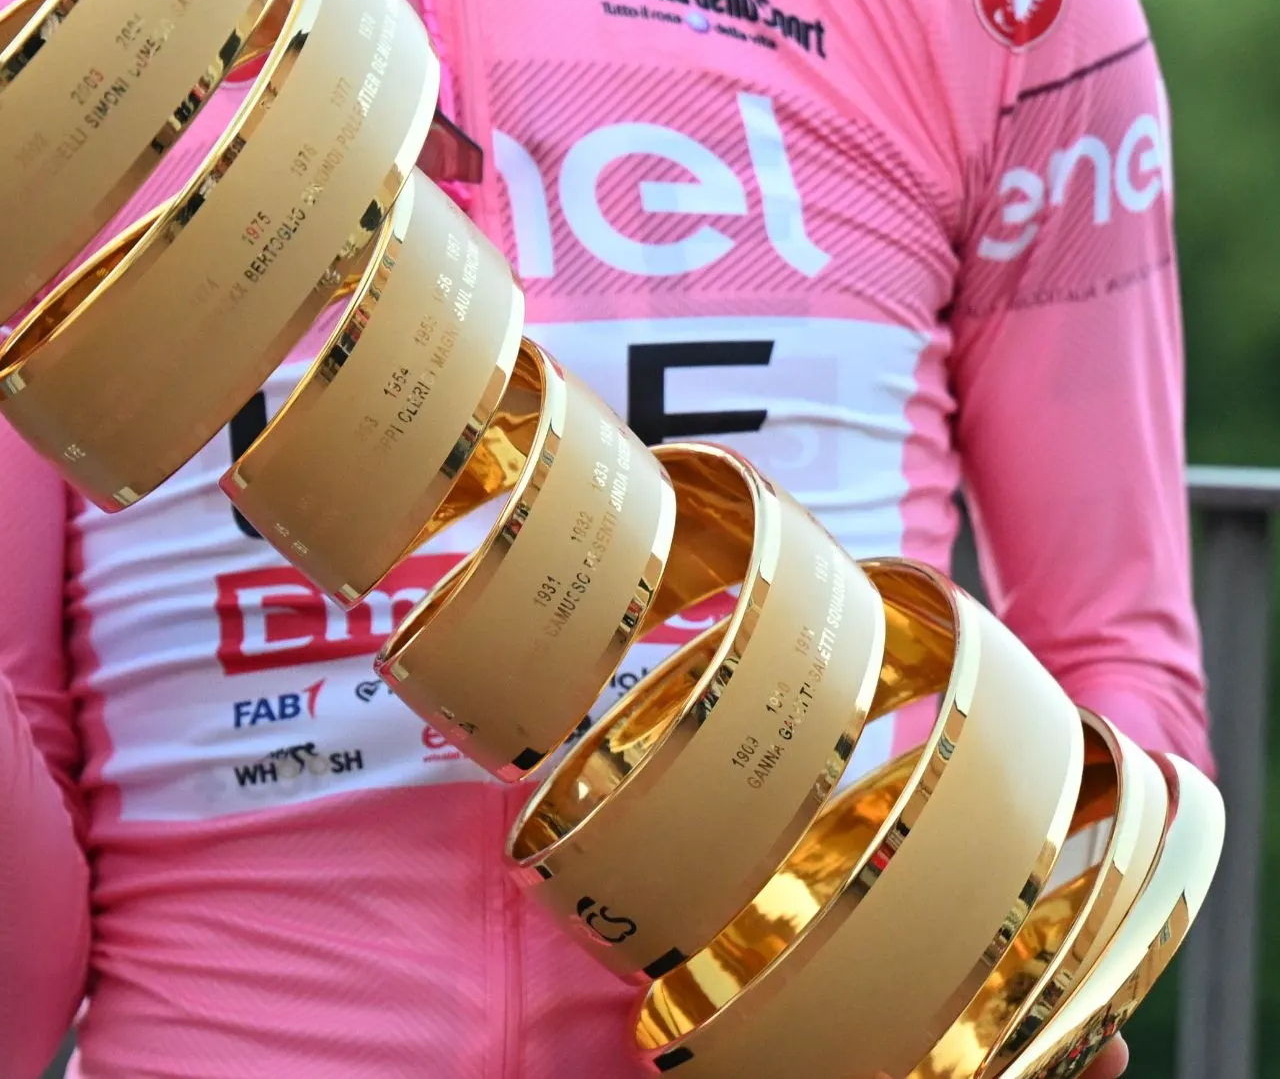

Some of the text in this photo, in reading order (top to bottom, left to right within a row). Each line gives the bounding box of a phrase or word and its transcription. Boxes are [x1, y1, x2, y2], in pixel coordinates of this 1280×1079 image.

[71, 68, 105, 106] 2003
[85, 76, 129, 128] SIMONI
[241, 211, 271, 246] 1975
[329, 77, 354, 109] 1977
[977, 111, 1168, 261] ene
[246, 207, 306, 282] BERTOGLIO
[449, 288, 474, 321] GAUL
[383, 366, 410, 398] 1954
[534, 574, 560, 607] 1931
[570, 510, 593, 543] 1932
[731, 735, 758, 769] 1909
[747, 742, 783, 790] GANNA
